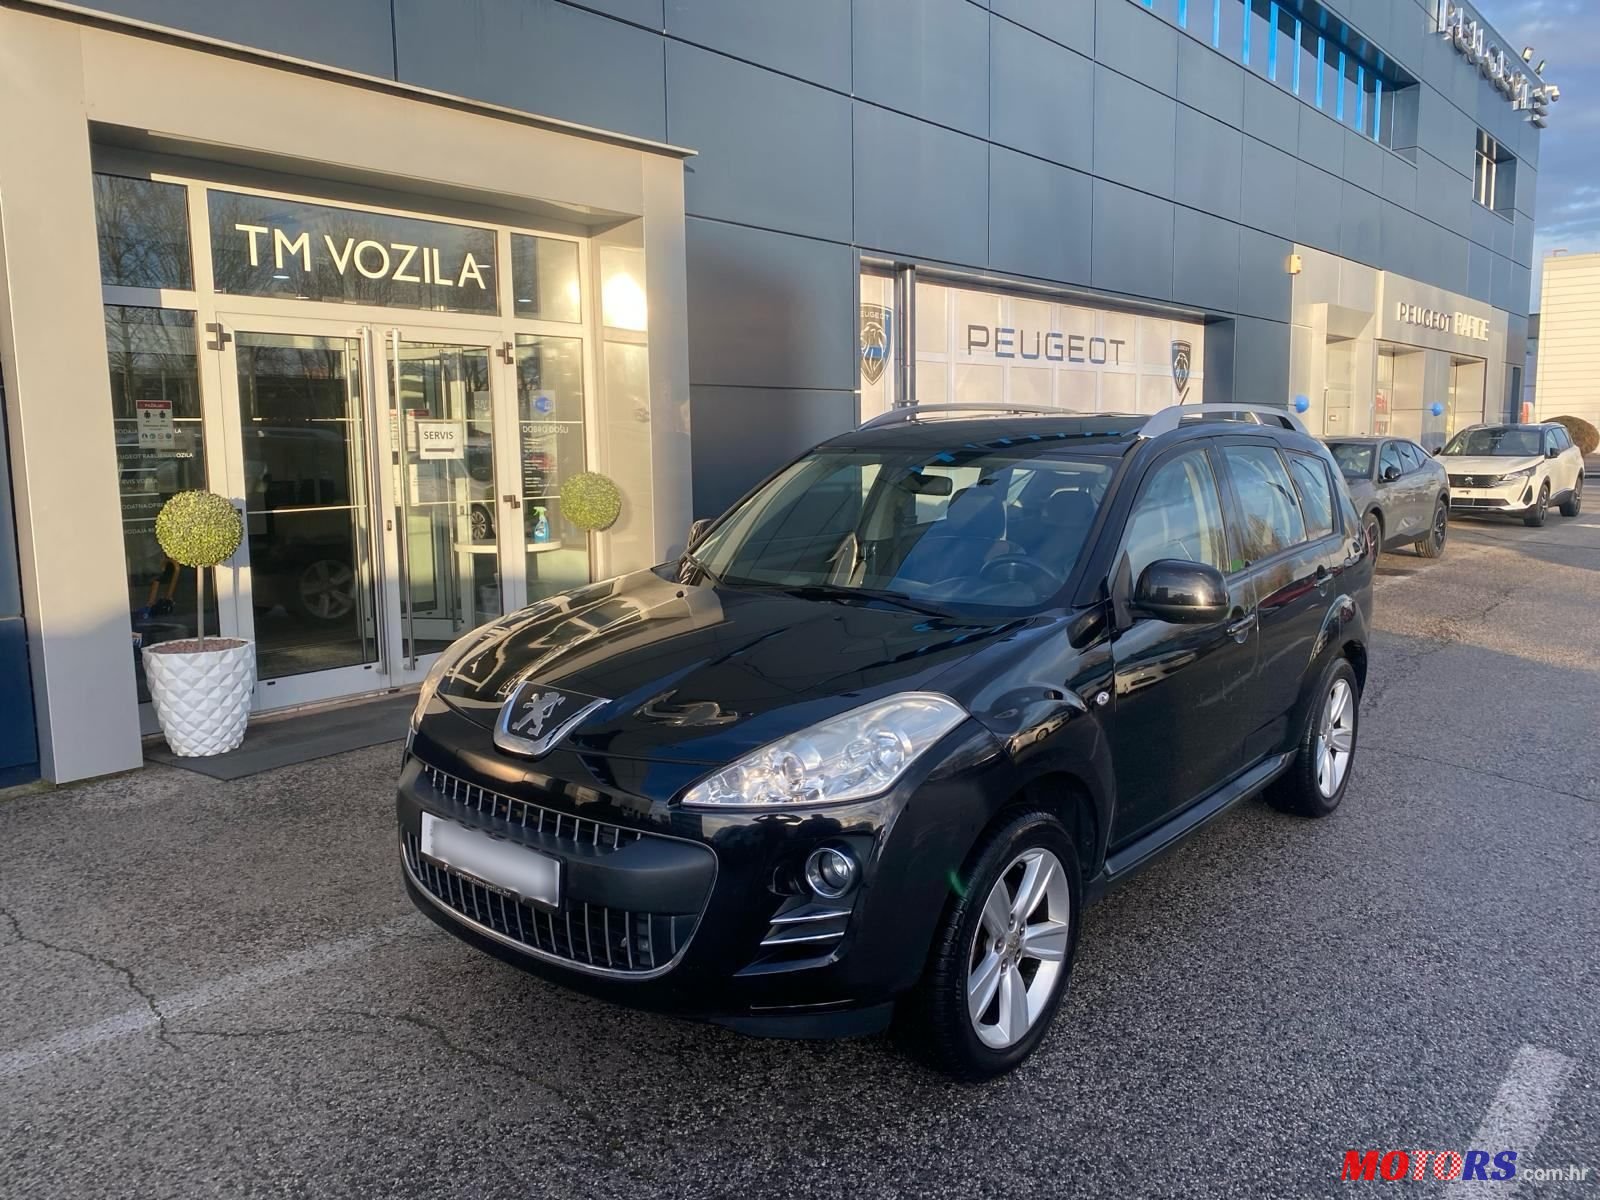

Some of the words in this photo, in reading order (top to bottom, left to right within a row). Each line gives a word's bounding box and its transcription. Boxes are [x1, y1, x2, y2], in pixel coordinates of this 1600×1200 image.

[235, 223, 311, 272] TM
[324, 234, 486, 290] VOZILA
[860, 311, 890, 321] EUGEOT
[1397, 301, 1453, 333] PEUGEOT
[967, 324, 1126, 366] PEUGEOT
[423, 431, 454, 441] SERVIS
